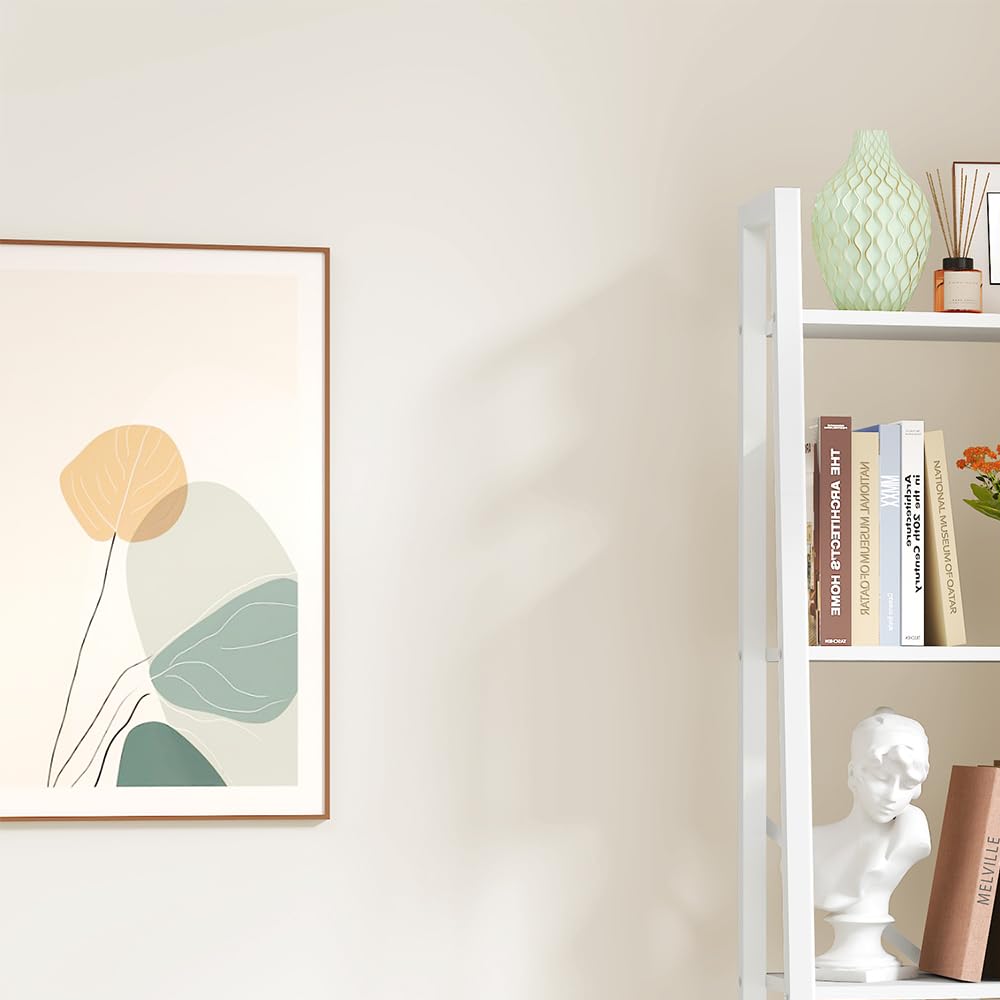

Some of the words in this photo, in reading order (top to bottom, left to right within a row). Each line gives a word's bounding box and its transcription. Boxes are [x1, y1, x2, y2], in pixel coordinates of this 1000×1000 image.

[933, 460, 946, 514] NATIONAL
[939, 515, 952, 563] MUSEUM
[944, 563, 953, 578] OF
[977, 836, 1000, 906] MELVILLE
